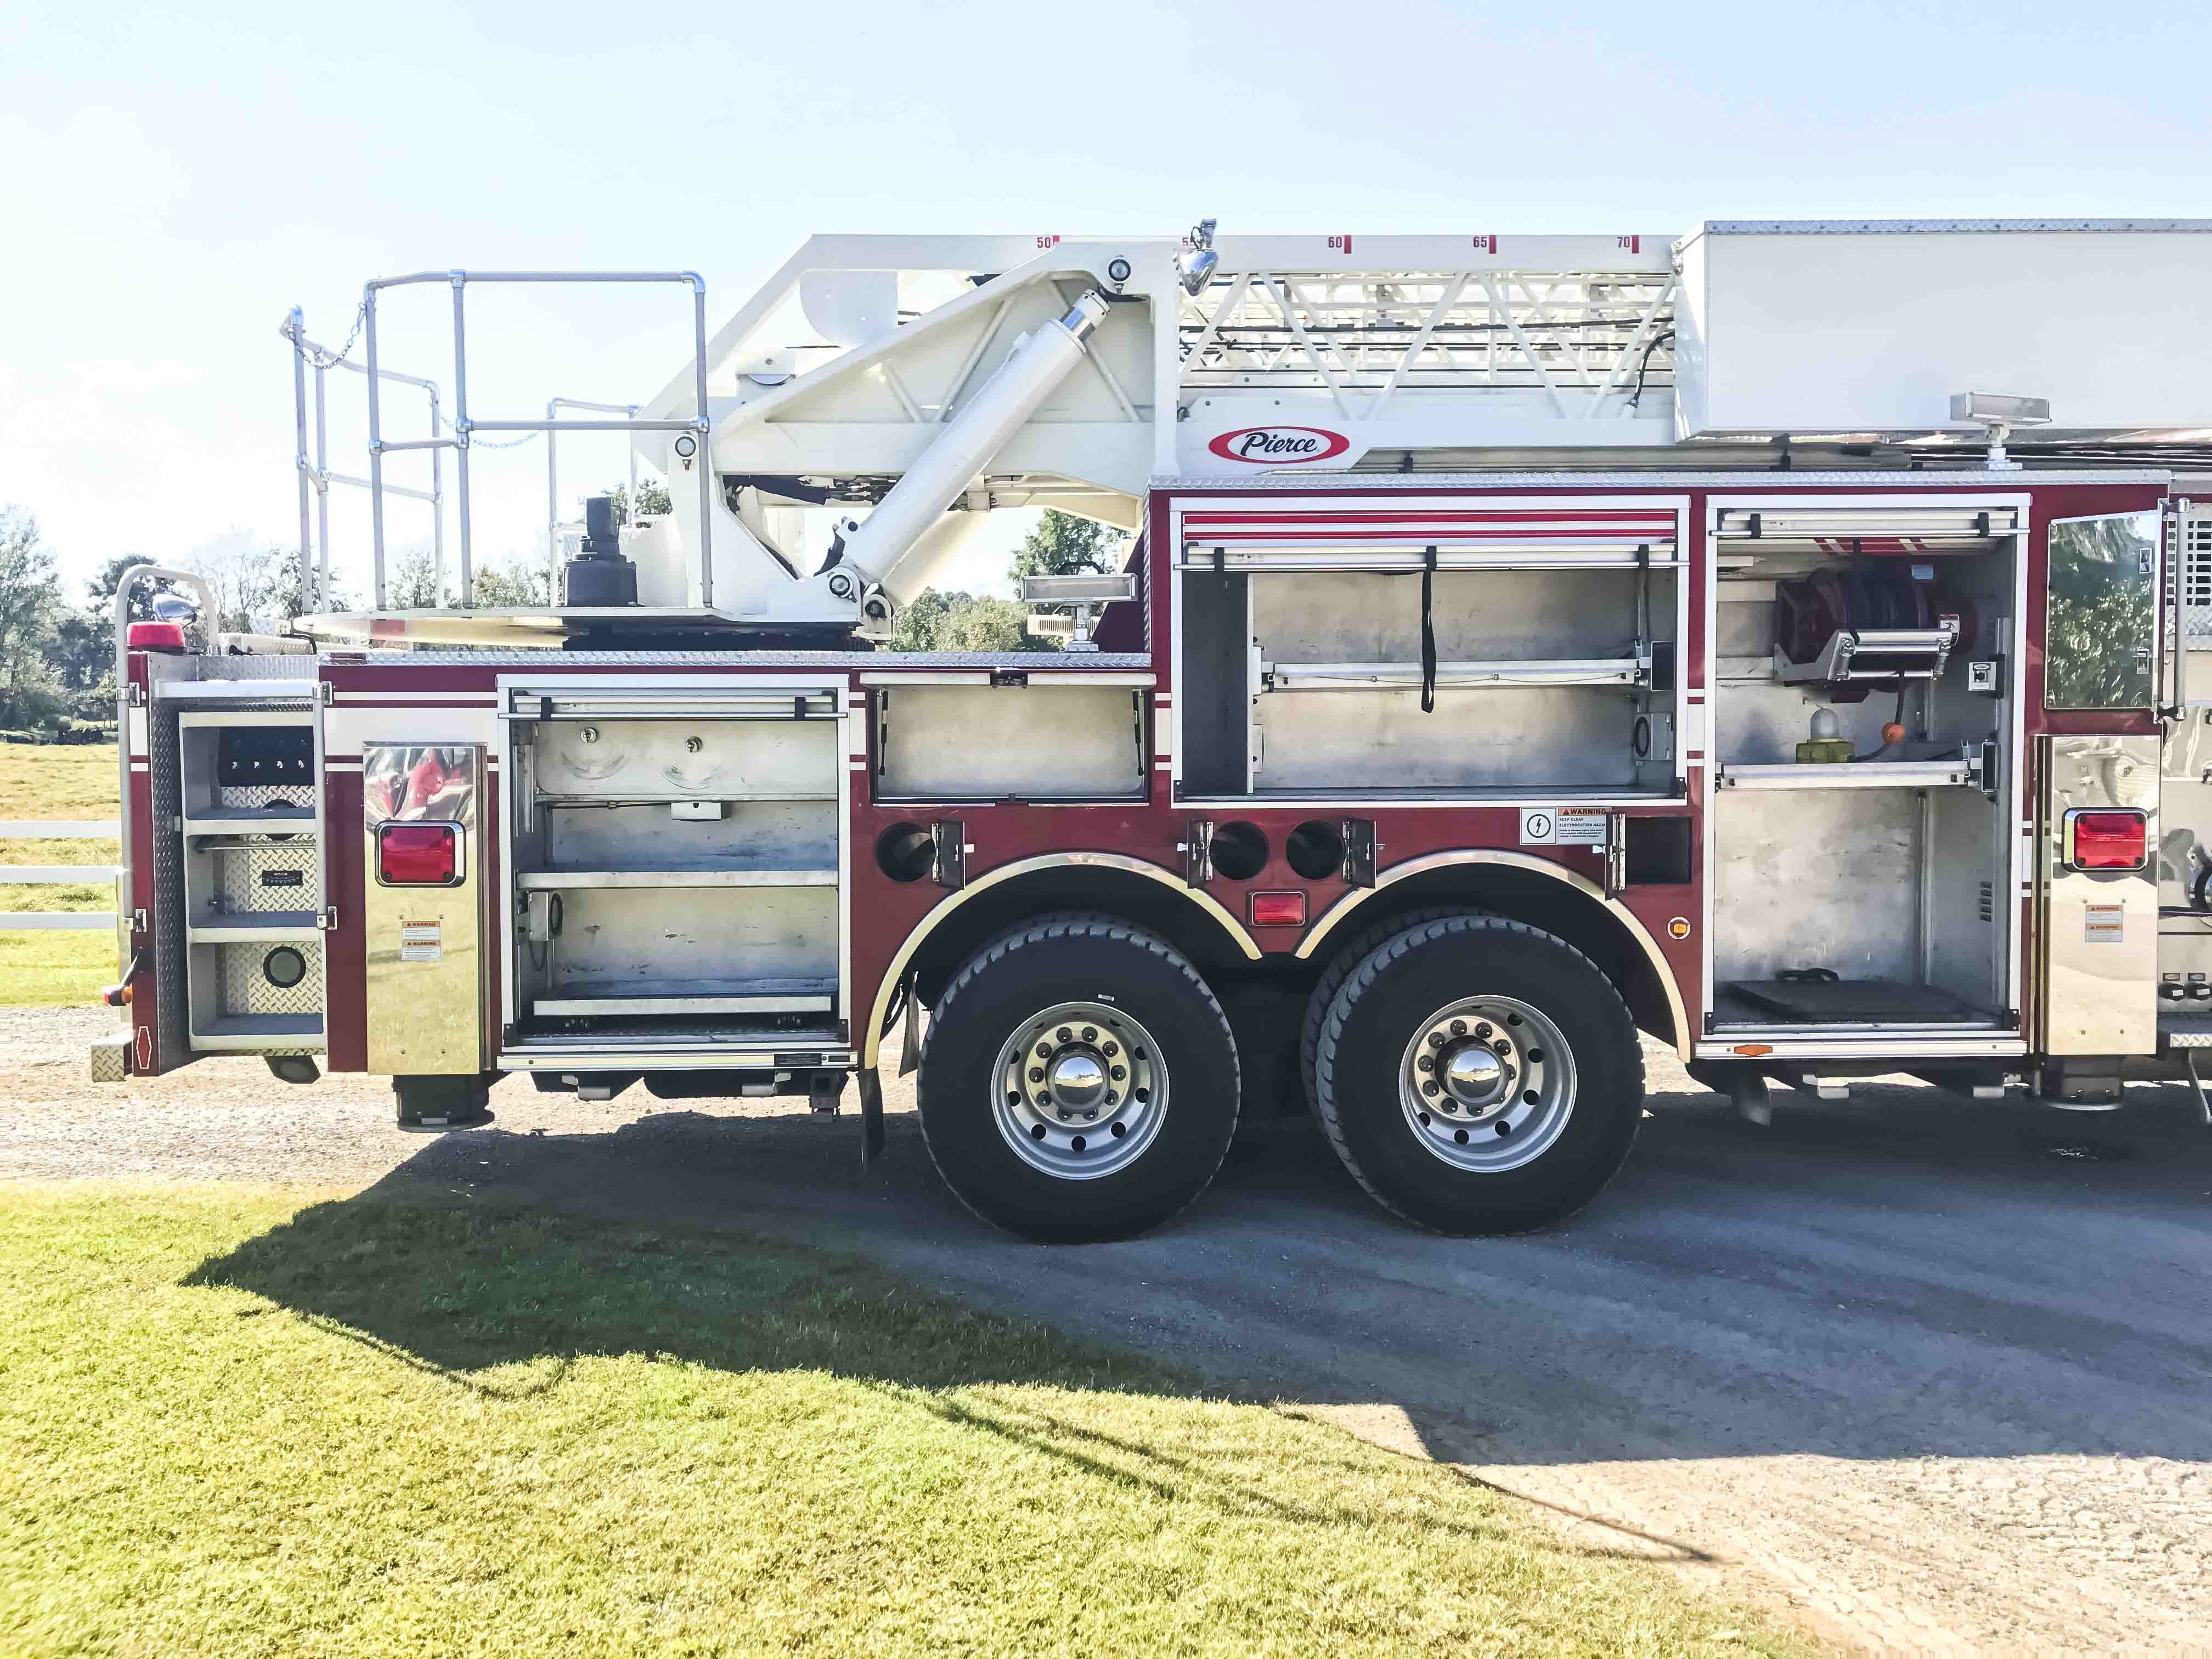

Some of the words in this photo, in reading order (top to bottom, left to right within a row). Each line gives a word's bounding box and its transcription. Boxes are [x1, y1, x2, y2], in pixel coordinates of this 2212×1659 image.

[1037, 236, 1051, 248] 50
[1328, 236, 1342, 248] 60
[1473, 236, 1487, 248] 65
[1617, 236, 1630, 247] 70
[1240, 432, 1317, 456] Pierce
